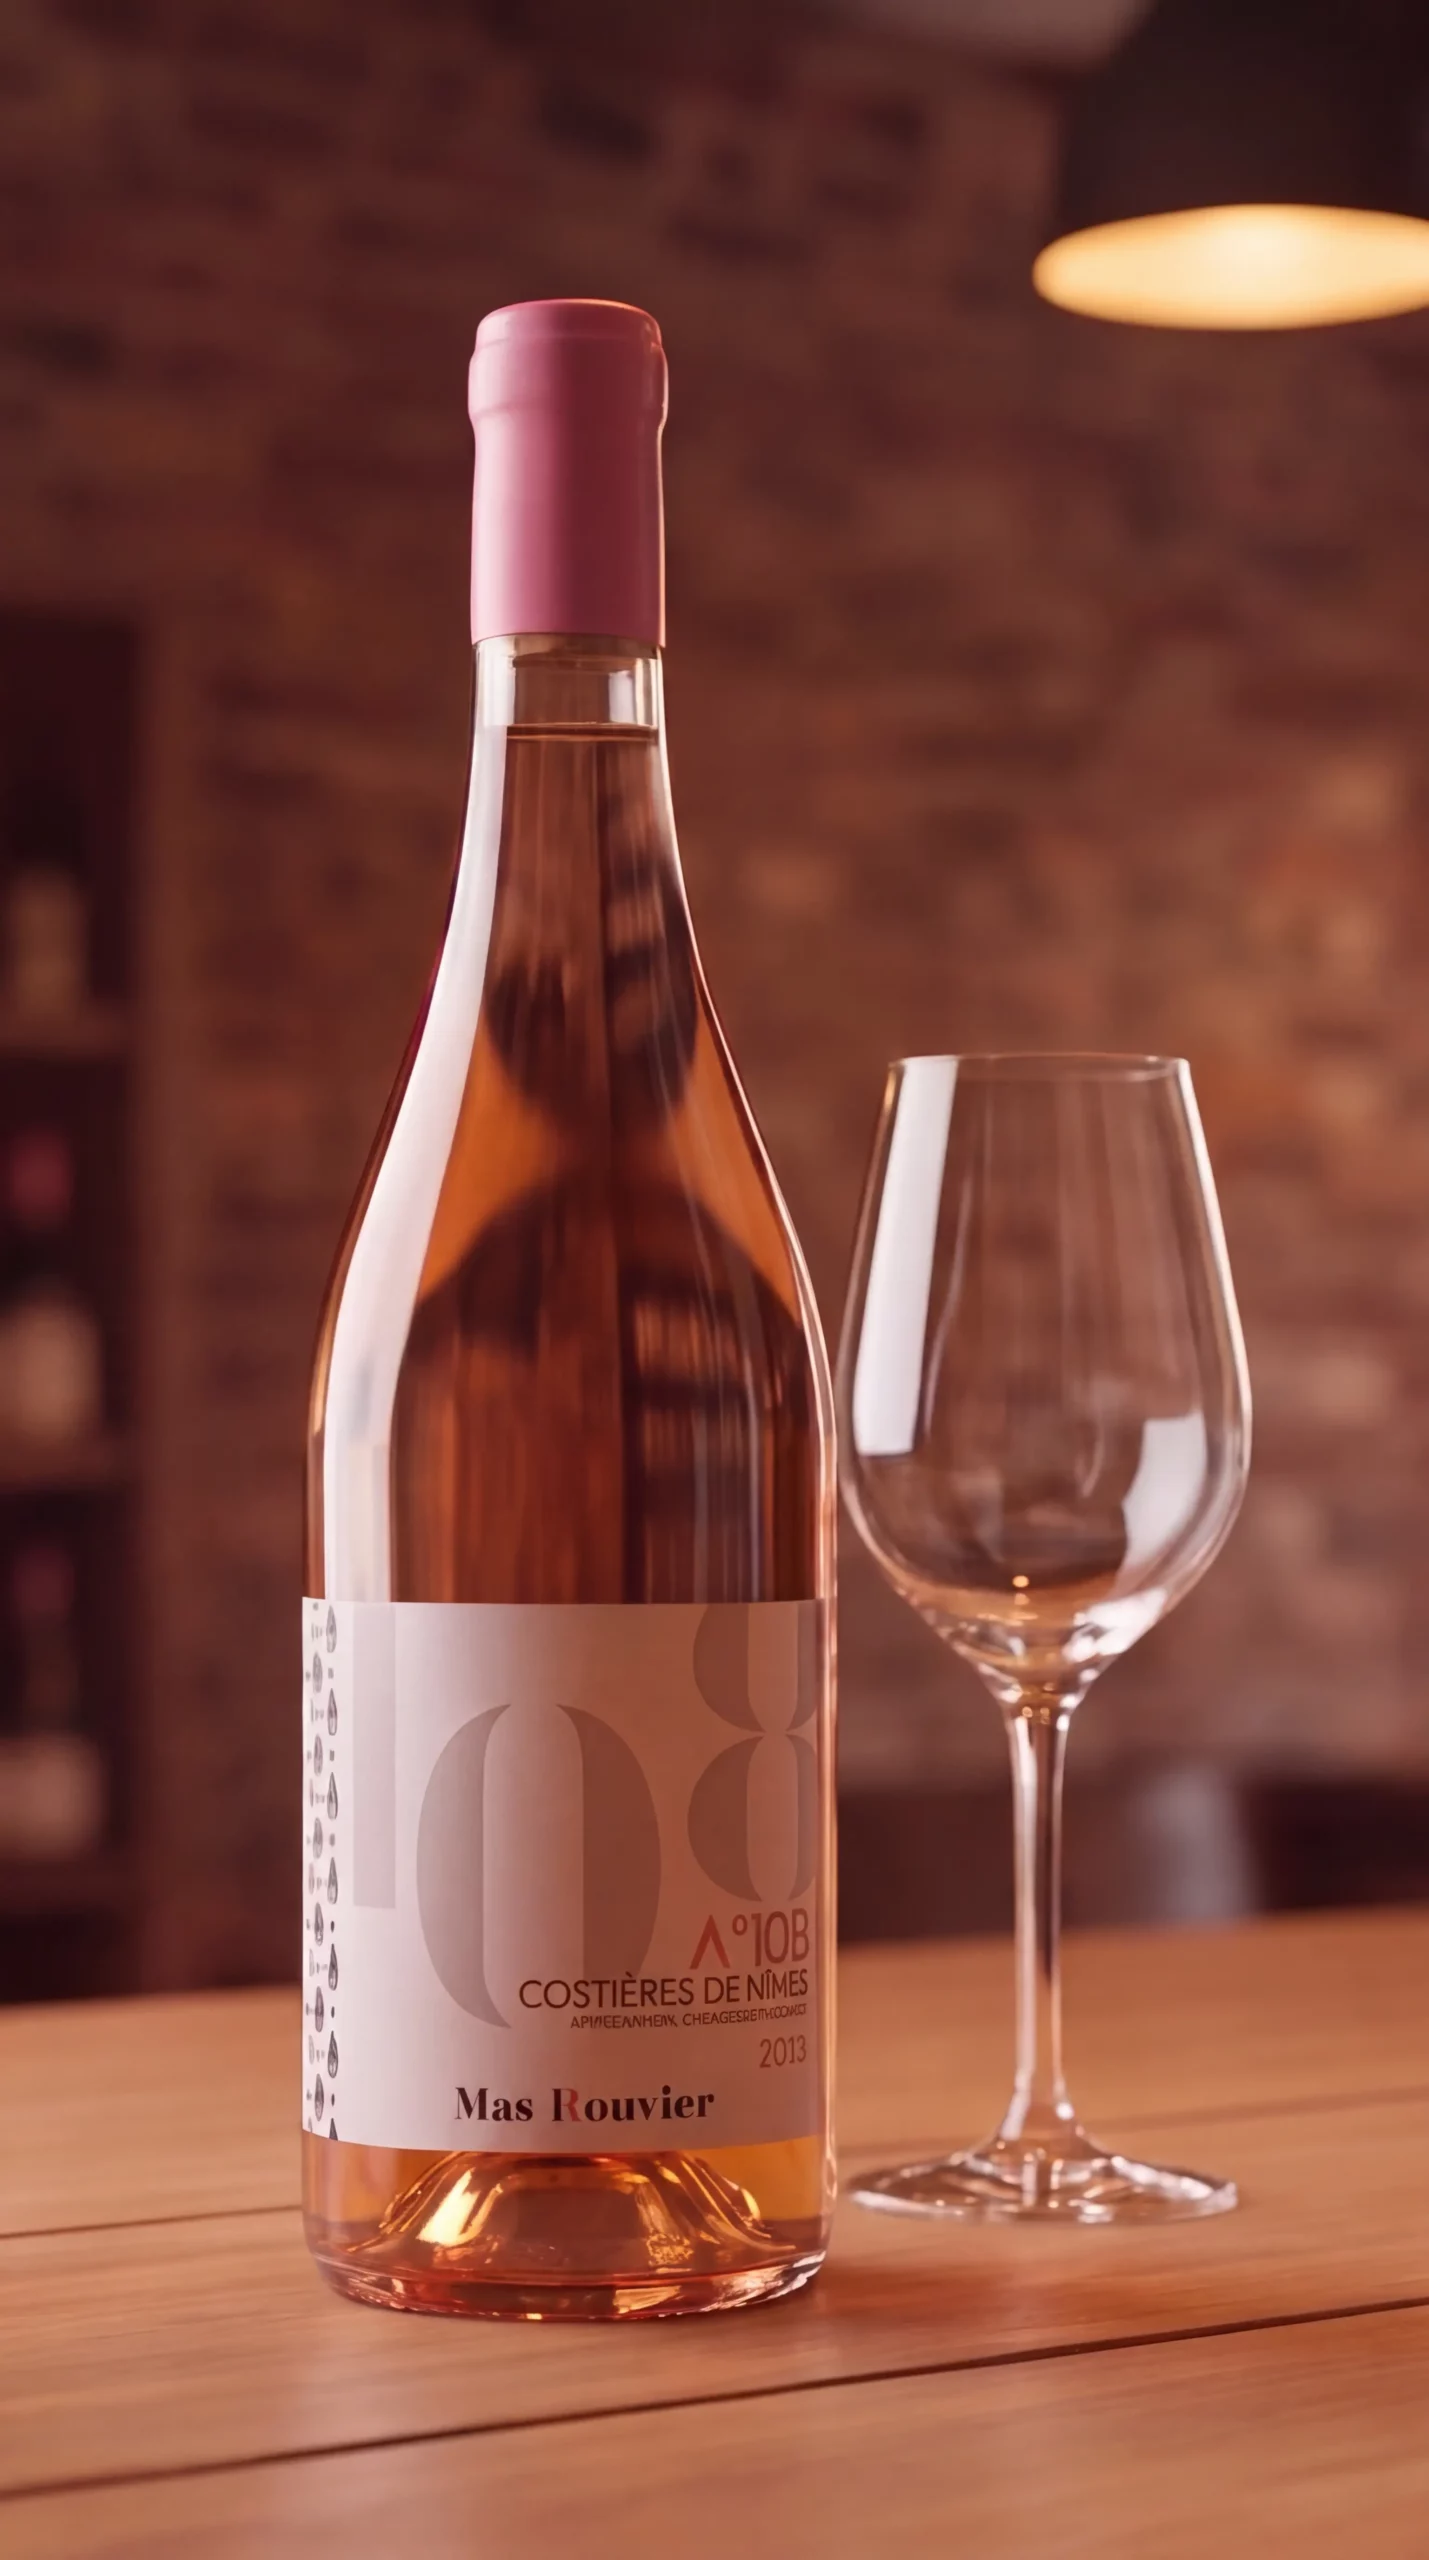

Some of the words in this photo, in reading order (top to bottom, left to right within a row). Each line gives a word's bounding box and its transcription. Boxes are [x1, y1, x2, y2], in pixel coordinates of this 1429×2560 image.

[518, 1971, 694, 2009] COSTIÈRES
[704, 1975, 740, 2005] DE
[746, 1969, 808, 2002] NÎMES
[759, 2034, 808, 2069] 2013
[454, 2086, 533, 2123] Mas
[551, 2084, 715, 2123] Rouvier
